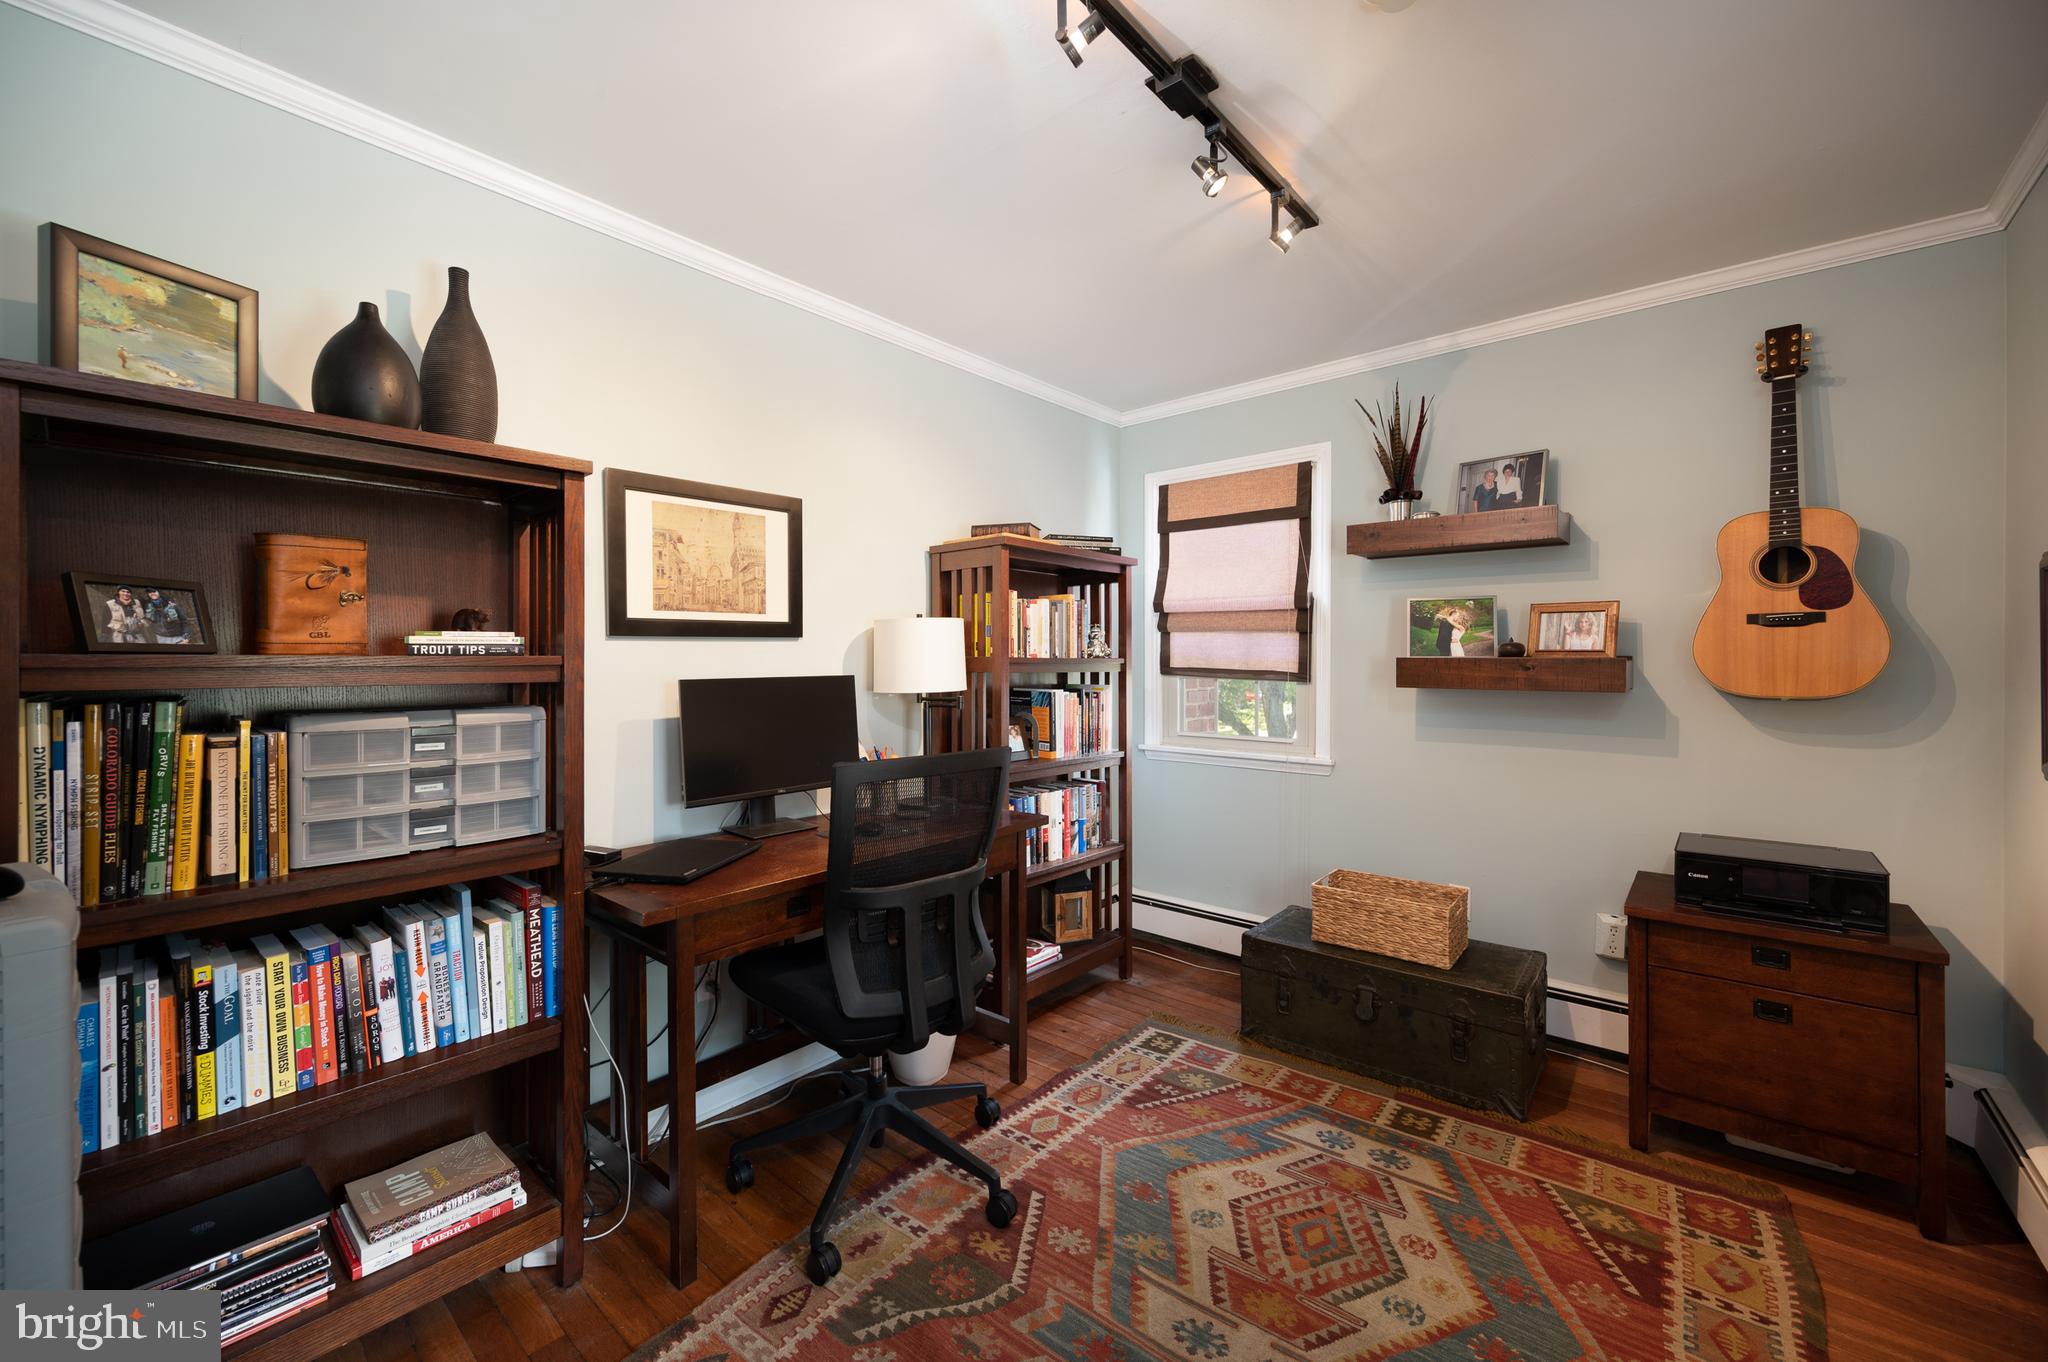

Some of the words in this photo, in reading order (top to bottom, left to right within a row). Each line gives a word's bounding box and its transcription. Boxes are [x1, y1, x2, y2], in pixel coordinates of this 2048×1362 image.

[412, 645, 453, 655] TROUT
[458, 645, 485, 655] TIPS
[105, 728, 120, 789] COLORADO
[157, 748, 168, 777] ORVIS
[268, 763, 276, 778] 101
[33, 747, 47, 800] DYNAMIC
[218, 751, 229, 800] KEYSTONE
[70, 779, 78, 803] NYMPH
[136, 794, 146, 803] FLY
[269, 779, 277, 811] TROUT
[70, 804, 78, 830] FISHING
[105, 793, 118, 830] GUIDE
[160, 803, 168, 826] SMALL
[219, 803, 229, 819] FLY
[269, 813, 277, 832] TIPS
[35, 803, 48, 864] NYMPHING
[54, 809, 64, 840] Prospecting
[56, 842, 64, 850] for
[104, 833, 118, 863] FLIES
[151, 824, 159, 853] FISHING
[158, 829, 166, 857] STREAM
[219, 822, 229, 860] FISHING
[56, 852, 64, 865] Trout
[413, 929, 422, 947] KEVIN
[530, 908, 542, 978] MEATHEAD
[273, 961, 284, 986] START
[316, 964, 325, 977] How
[452, 950, 463, 981] TRACTION
[244, 975, 252, 985] the
[332, 972, 340, 985] DAD
[433, 961, 445, 1021] GRANDFATHER
[442, 965, 451, 992] BONES
[479, 961, 487, 997] Proposition
[198, 990, 209, 1012] Stock
[244, 988, 252, 1008] signal
[274, 988, 285, 1010] YOUR
[317, 985, 326, 1000] Make
[121, 1005, 129, 1017] Case
[317, 1001, 328, 1020] Money
[445, 1001, 451, 1013] MY
[480, 998, 489, 1020] Design
[86, 1017, 95, 1047] CHARLES
[198, 1013, 210, 1049] Investing
[275, 1011, 287, 1033] OWN
[371, 1016, 380, 1051] SOROS
[320, 1027, 330, 1047] Stocks
[277, 1035, 289, 1074] BUSINESS
[199, 1062, 212, 1105] DUMMIES
[385, 1170, 435, 1207] CAMP
[445, 1189, 479, 1211] SUNSET
[419, 1221, 471, 1250] AMERICA
